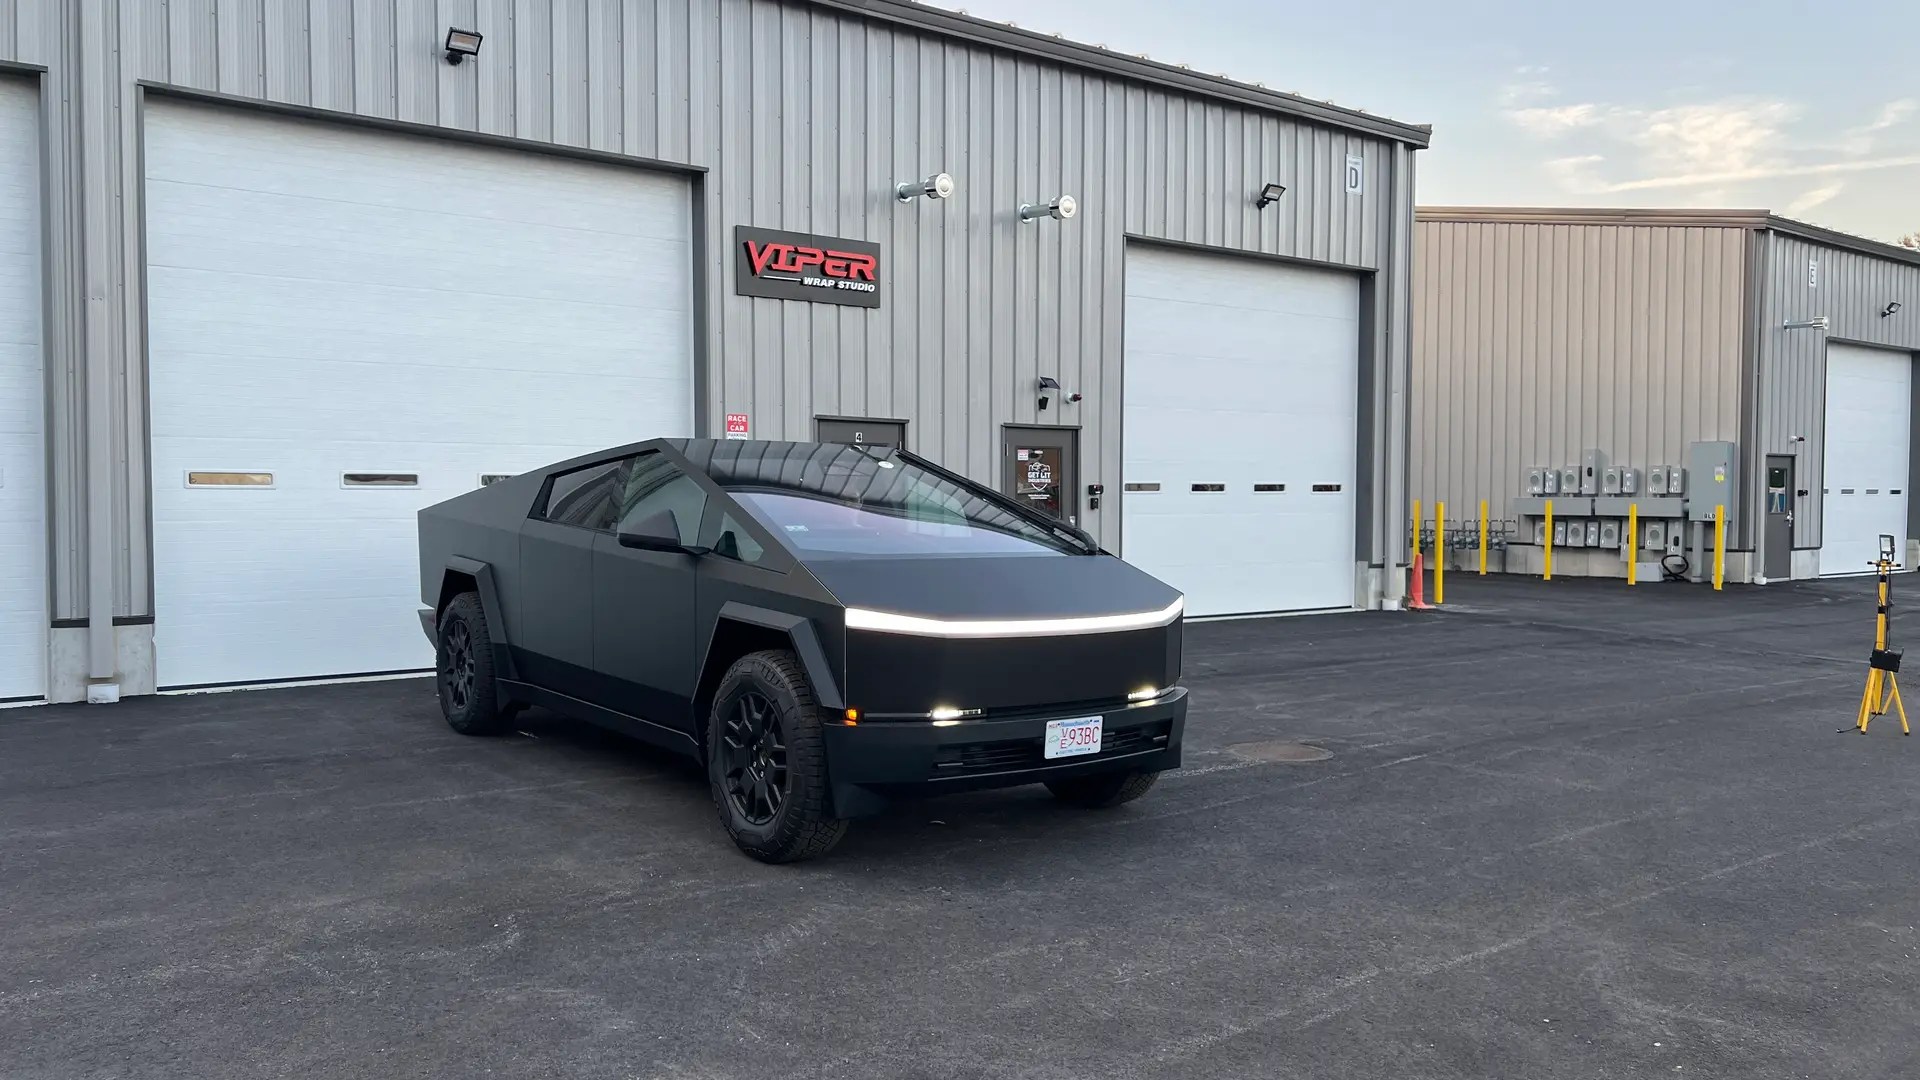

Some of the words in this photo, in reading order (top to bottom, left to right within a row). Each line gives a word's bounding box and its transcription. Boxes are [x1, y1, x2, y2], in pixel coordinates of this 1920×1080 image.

[1349, 166, 1358, 189] D
[746, 239, 876, 281] VIPER
[1810, 268, 1815, 284] E
[803, 276, 836, 288] WRAP
[837, 281, 876, 293] STUDIO
[727, 415, 747, 423] RACE
[729, 424, 745, 432] CAR
